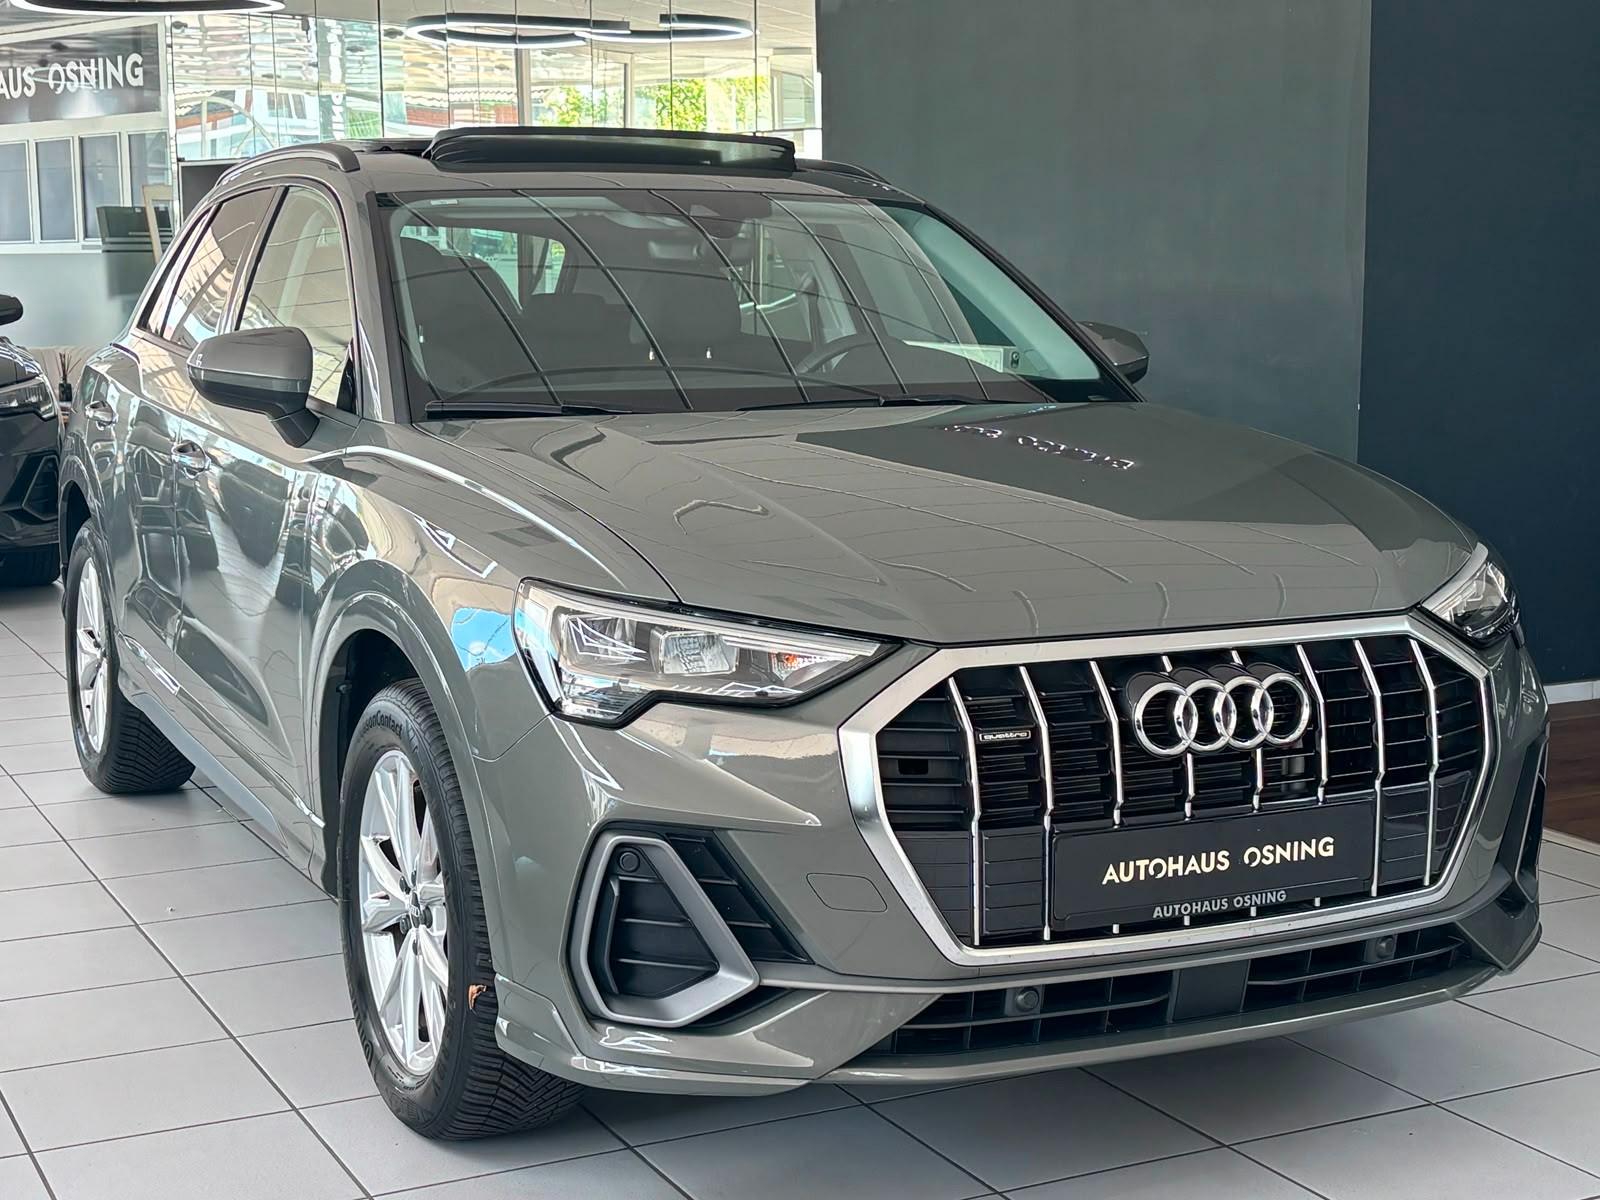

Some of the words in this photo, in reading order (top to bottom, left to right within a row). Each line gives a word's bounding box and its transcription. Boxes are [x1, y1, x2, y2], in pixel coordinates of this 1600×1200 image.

[48, 52, 144, 95] OSNING
[983, 731, 1028, 740] quattro
[1101, 850, 1230, 885] AUTOHAUS
[1243, 836, 1334, 868] OSNING
[1152, 897, 1229, 919] AUTOHAUS
[1232, 890, 1287, 909] OSNING
